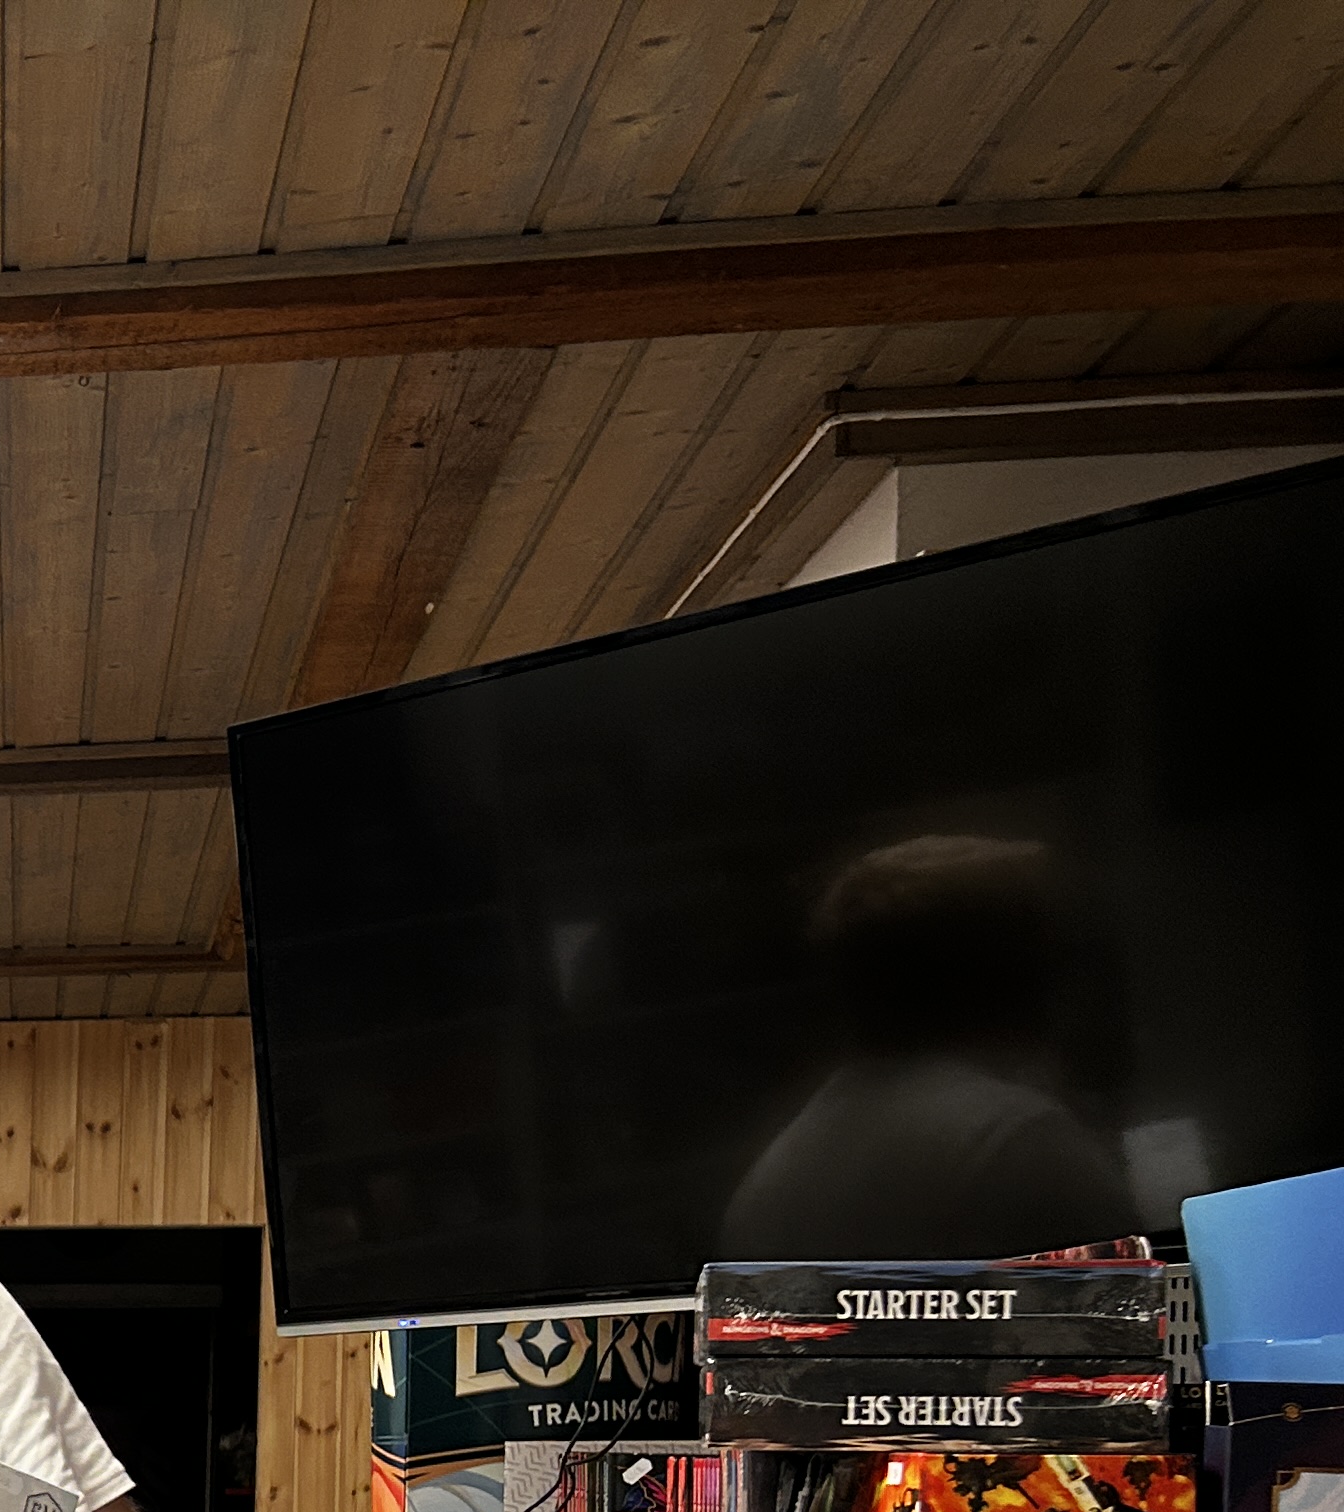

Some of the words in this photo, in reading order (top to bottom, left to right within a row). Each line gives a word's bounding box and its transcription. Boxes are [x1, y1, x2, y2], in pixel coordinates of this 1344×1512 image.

[836, 1289, 966, 1321] STARTER
[969, 1289, 1018, 1321] SET
[528, 1400, 642, 1428] TRADING
[841, 1395, 892, 1426] SET
[898, 1396, 1024, 1427] STARTER
